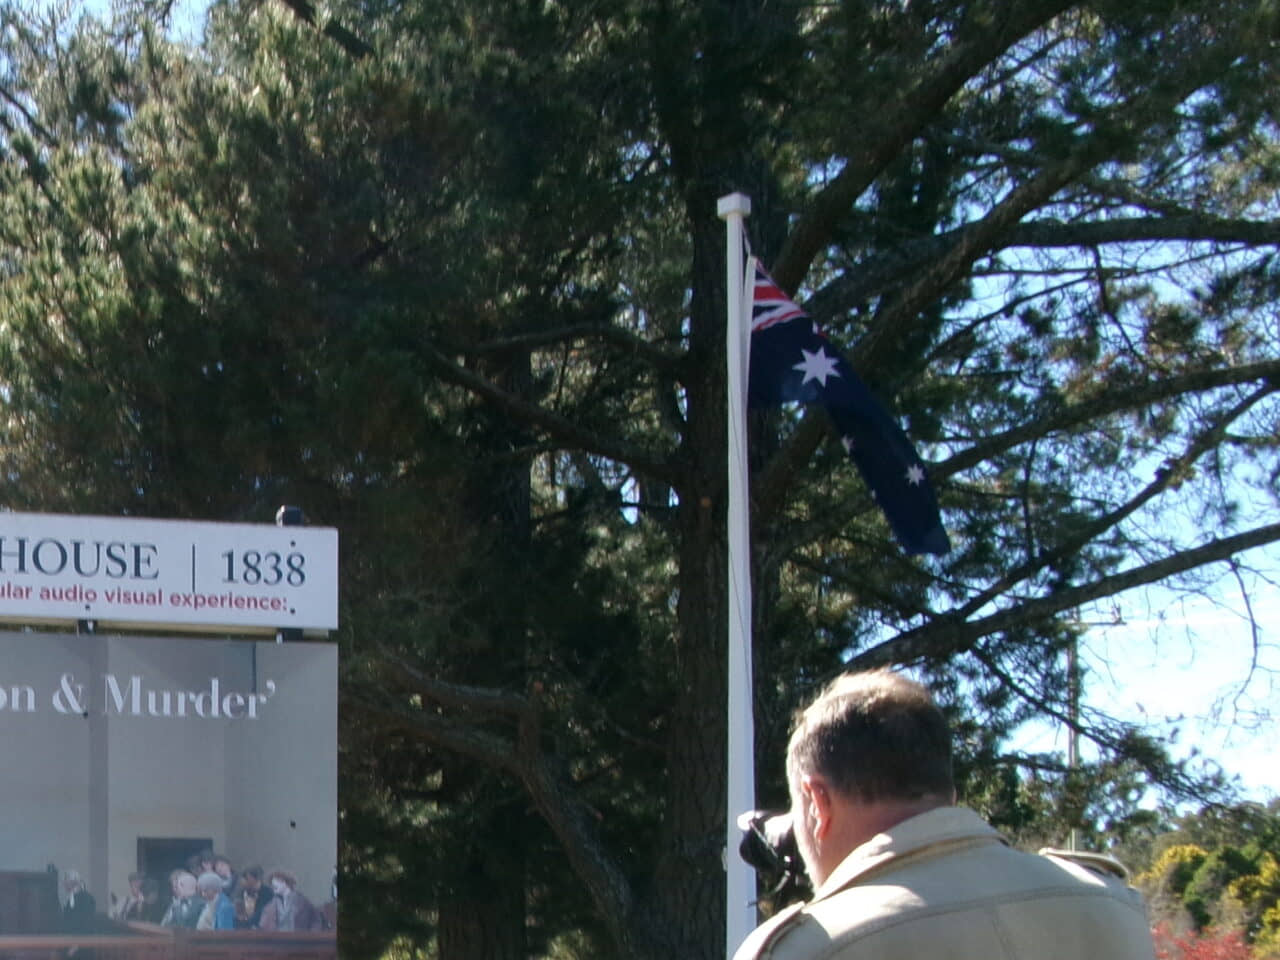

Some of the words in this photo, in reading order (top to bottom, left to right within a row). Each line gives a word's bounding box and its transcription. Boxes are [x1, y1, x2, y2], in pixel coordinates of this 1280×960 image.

[221, 548, 306, 587] 1838
[39, 583, 98, 603] audio
[104, 588, 163, 606] visual
[169, 592, 289, 612] experience:
[52, 672, 87, 714] &
